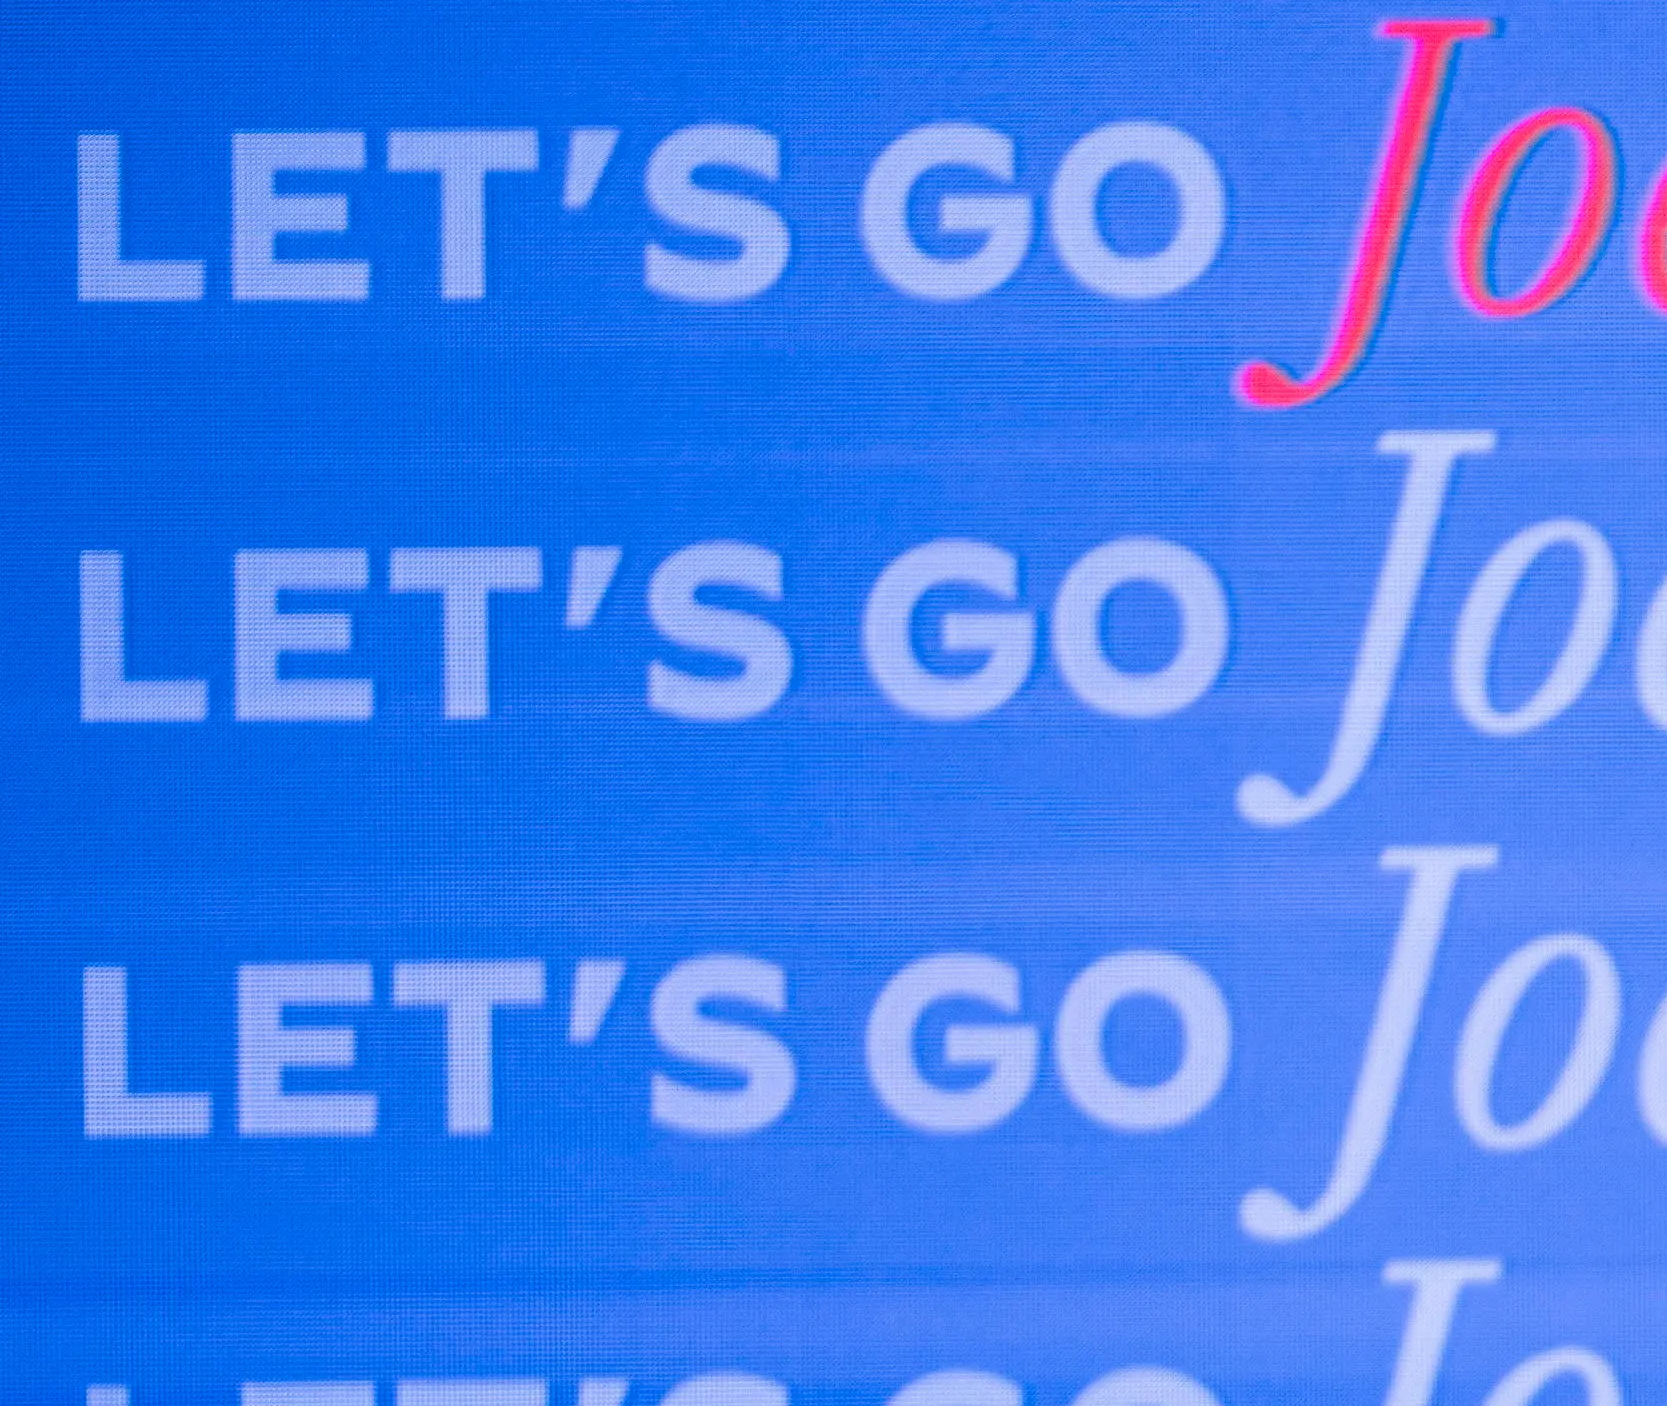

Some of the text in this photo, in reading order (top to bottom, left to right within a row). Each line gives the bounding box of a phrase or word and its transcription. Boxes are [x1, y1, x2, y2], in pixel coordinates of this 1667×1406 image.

[77, 121, 791, 306] LET'S
[857, 120, 1226, 305] GO
[79, 539, 792, 724] LET'S
[859, 536, 1227, 723] GO
[82, 952, 797, 1140] LET'S
[863, 949, 1231, 1136] GO
